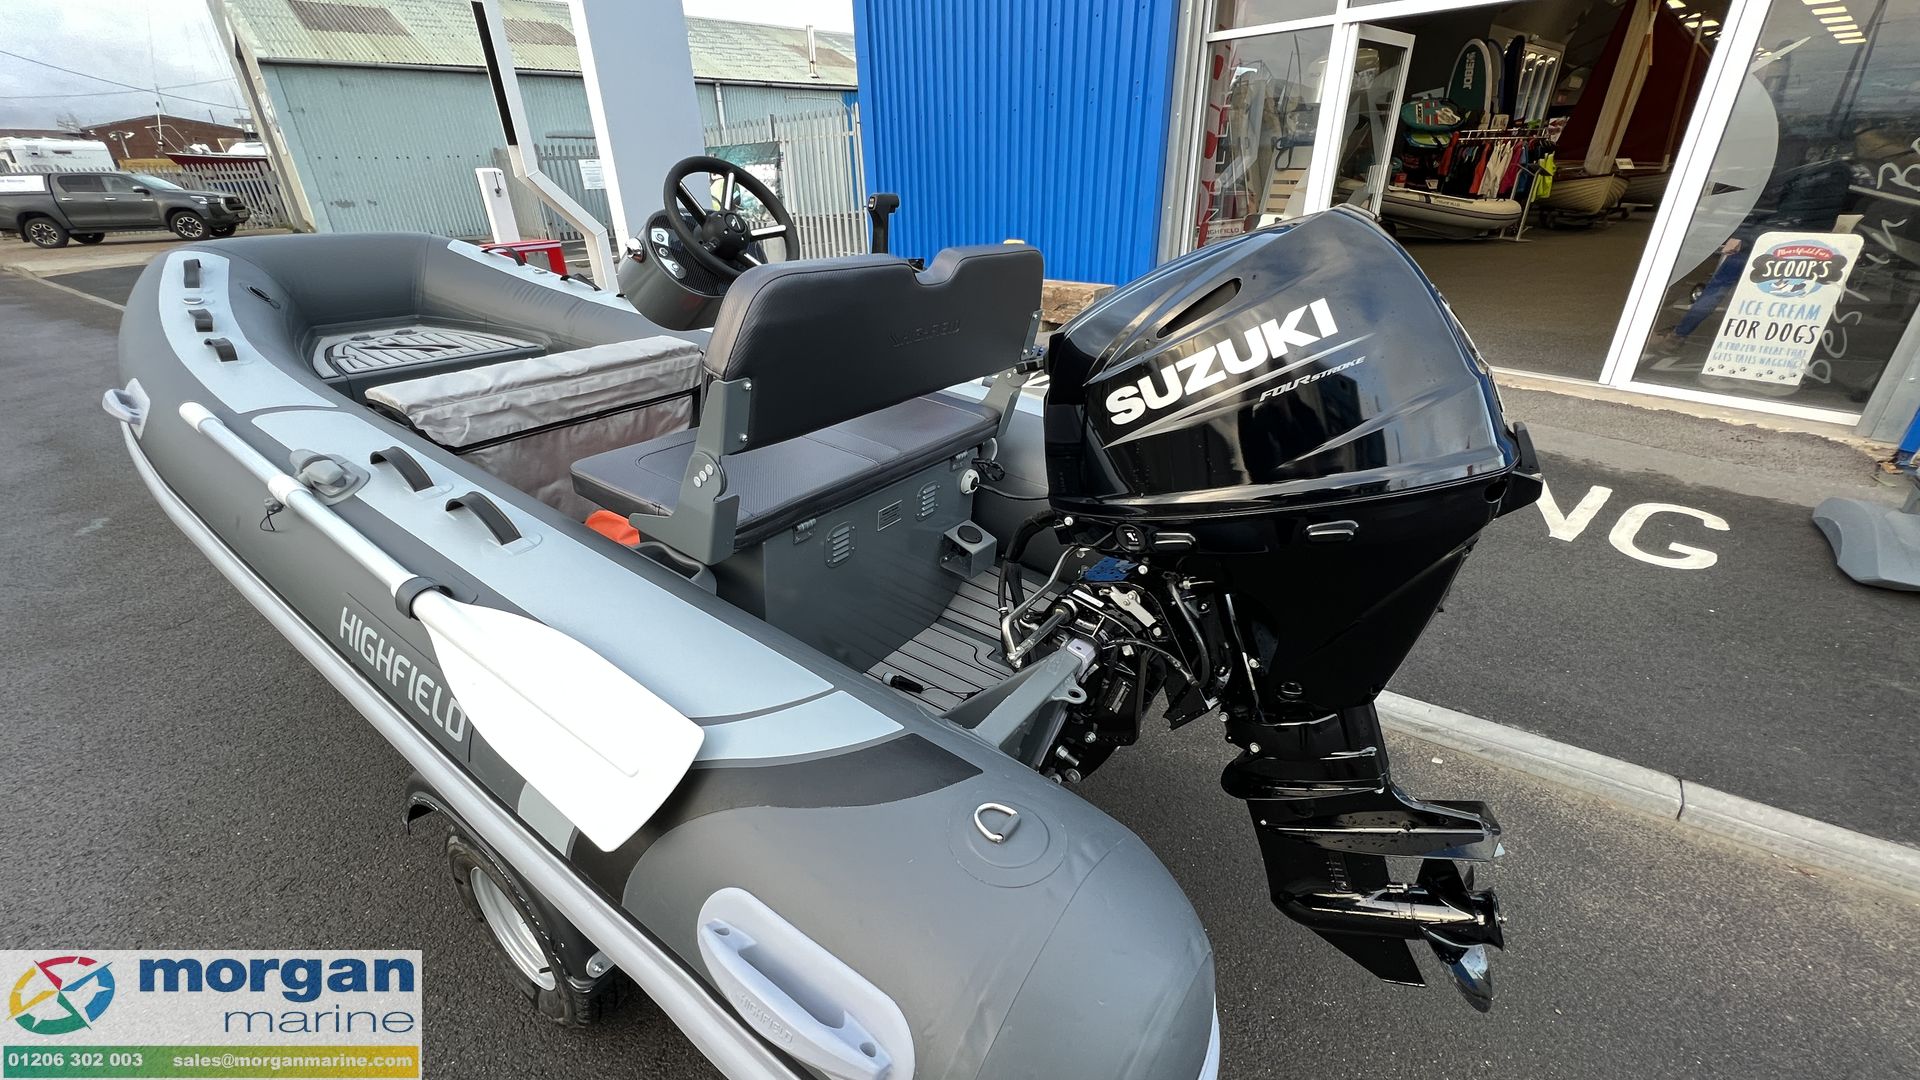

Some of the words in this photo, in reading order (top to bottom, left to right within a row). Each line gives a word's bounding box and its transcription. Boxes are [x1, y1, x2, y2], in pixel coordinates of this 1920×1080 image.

[1761, 260, 1833, 278] SCOOP'S
[1738, 300, 1763, 317] ICE
[1767, 302, 1822, 321] CREAM
[1723, 318, 1760, 339] FOR
[1764, 322, 1820, 345] DOGS
[1105, 297, 1339, 426] SUZUKI
[339, 606, 467, 742] HIGHFIELD
